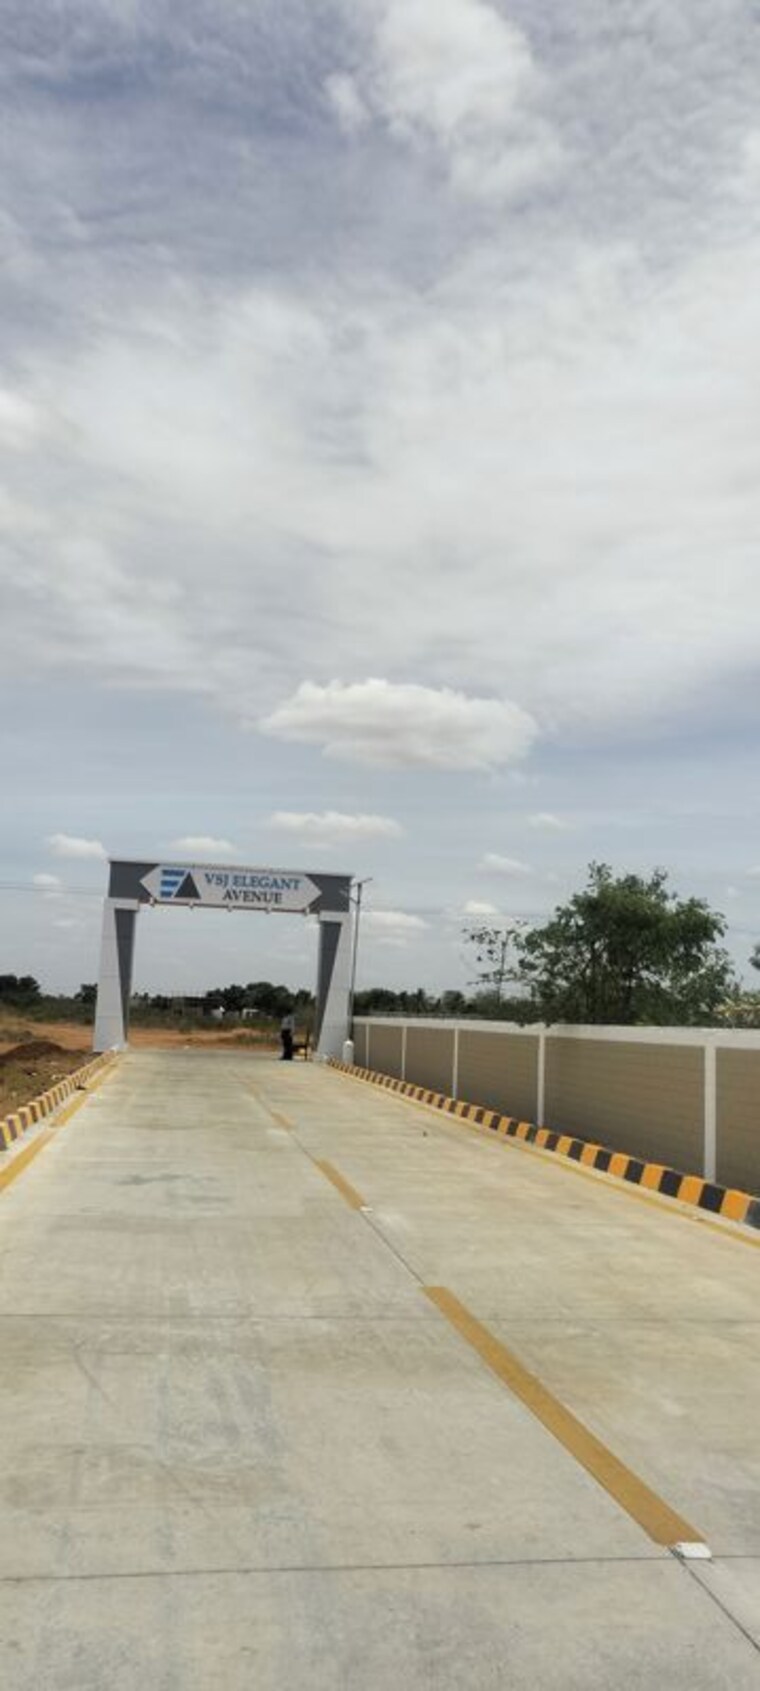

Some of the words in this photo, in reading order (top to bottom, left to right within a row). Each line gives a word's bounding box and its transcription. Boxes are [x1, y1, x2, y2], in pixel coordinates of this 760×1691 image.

[204, 873, 229, 888] VSJ
[232, 875, 301, 890] ELEGANT
[222, 889, 282, 904] AVENUE
